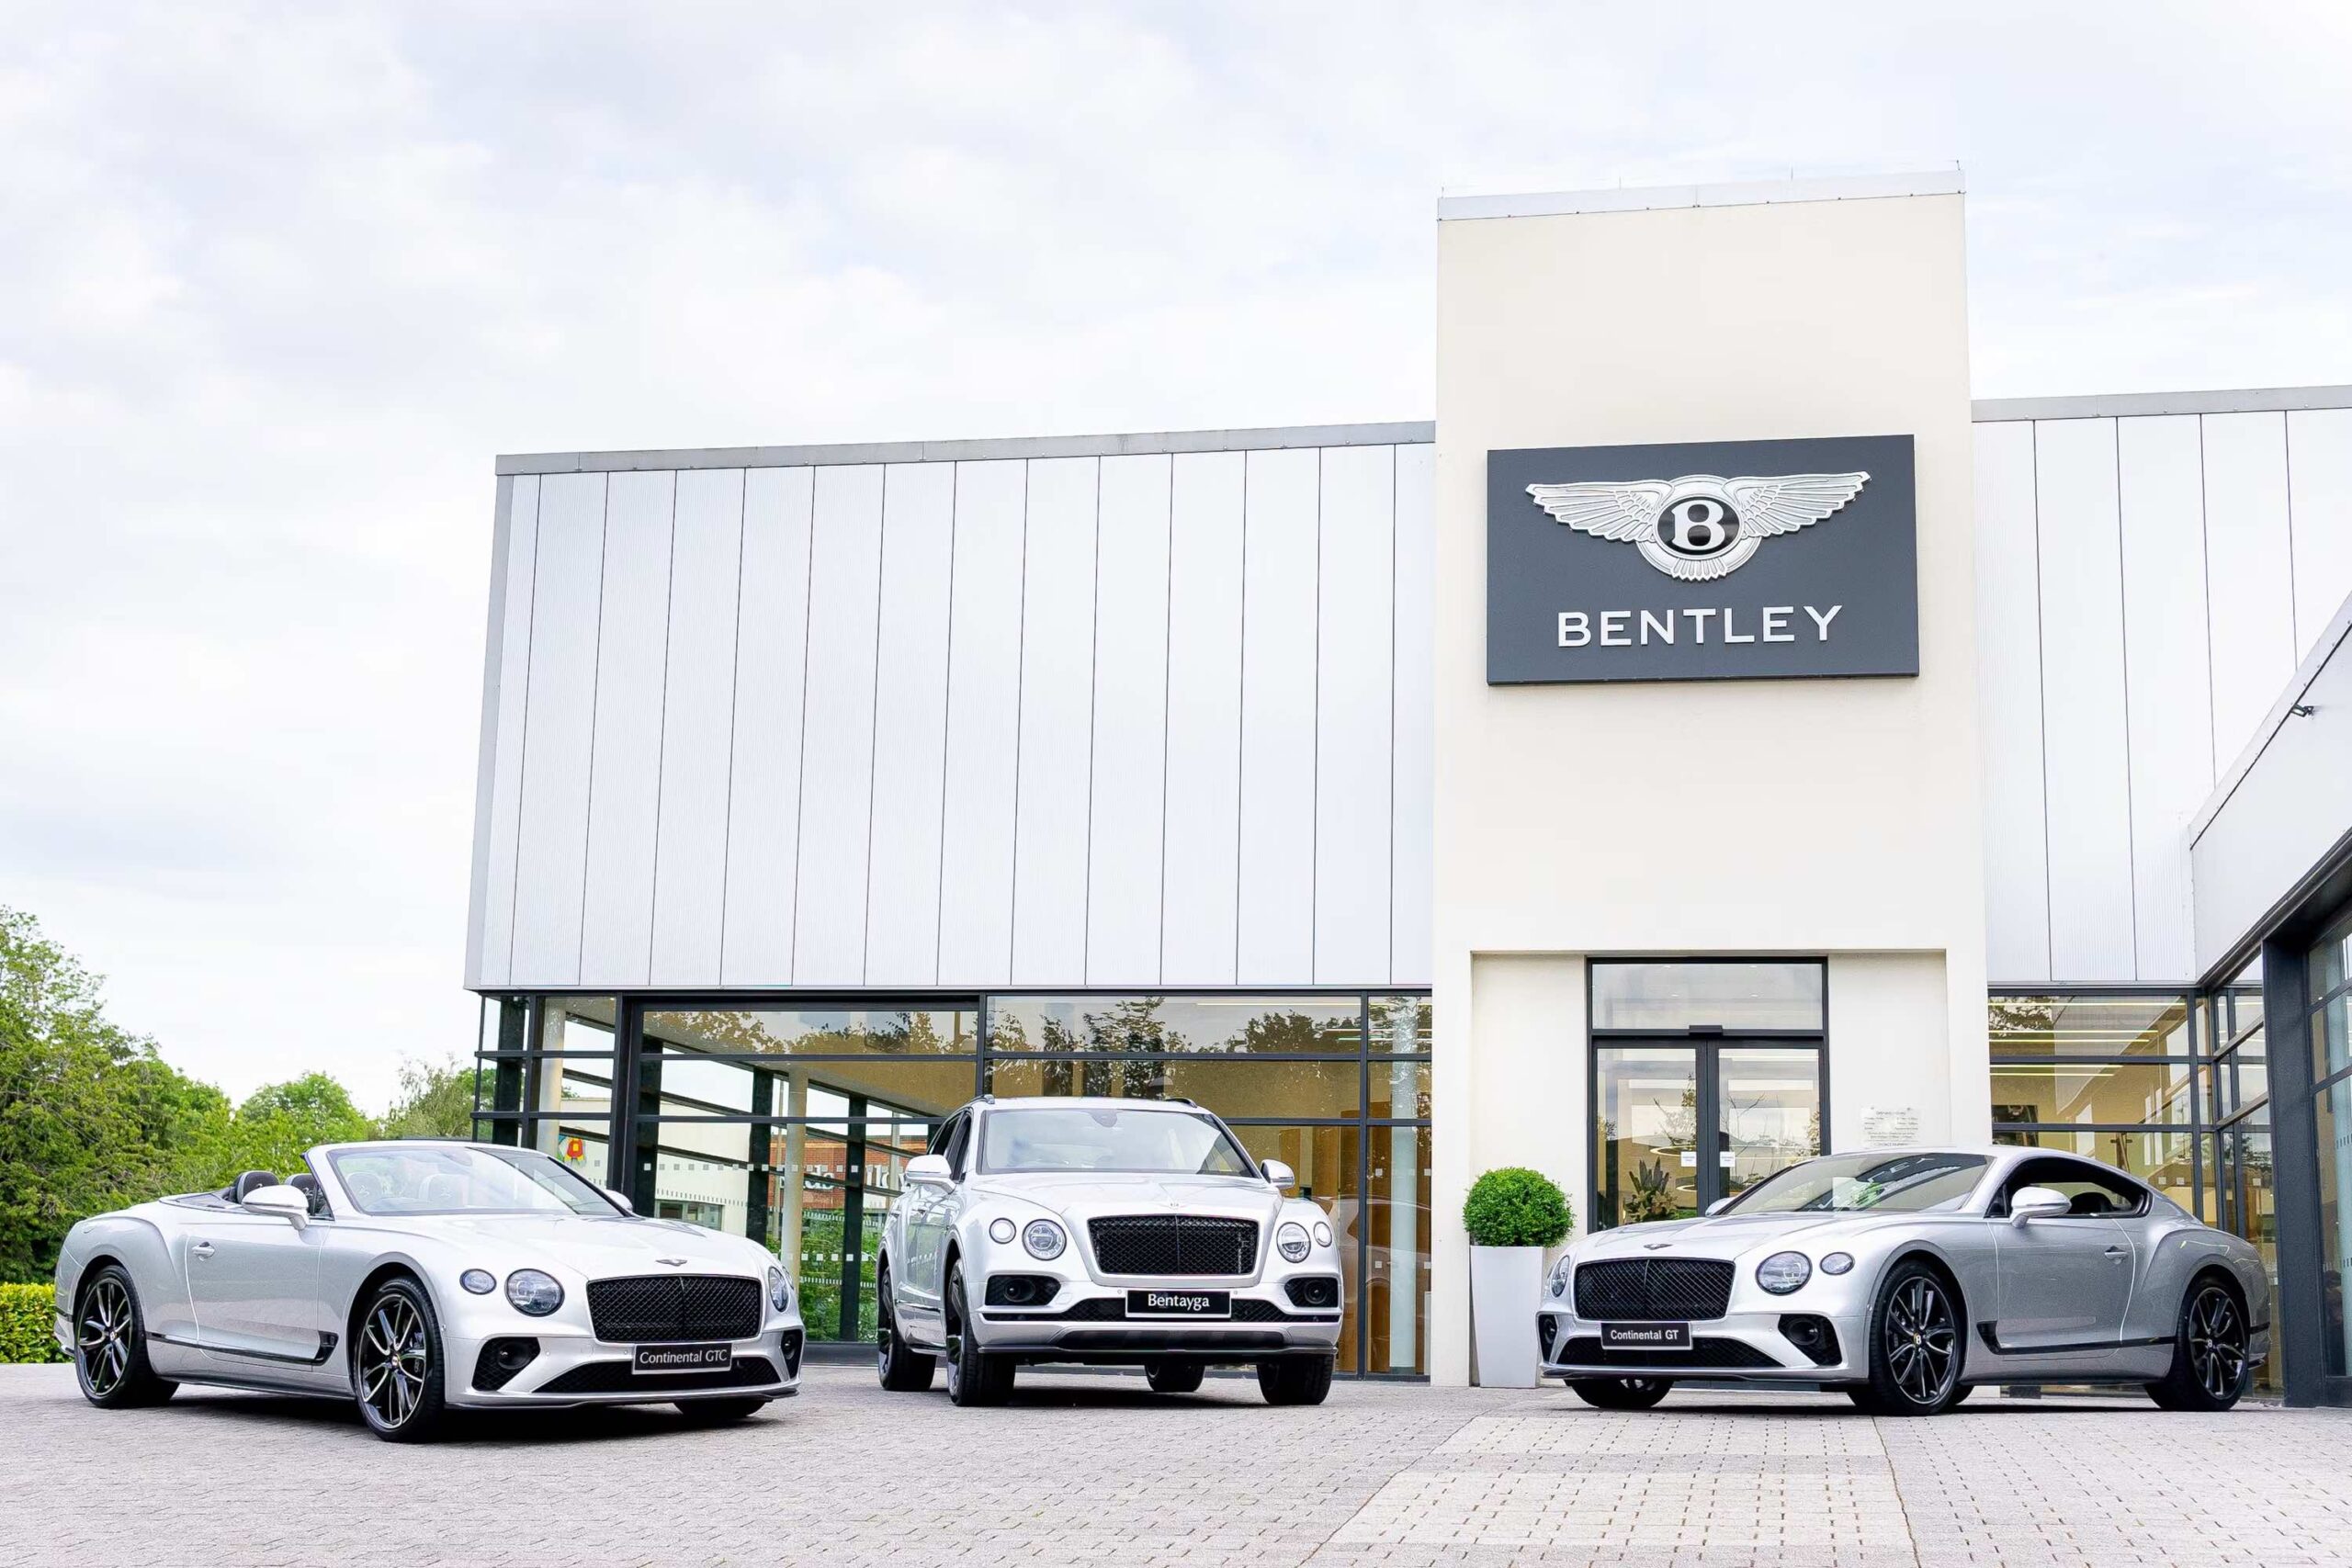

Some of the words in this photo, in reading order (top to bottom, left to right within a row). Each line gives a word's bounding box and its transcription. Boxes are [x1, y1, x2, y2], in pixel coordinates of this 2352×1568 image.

[1671, 499, 1725, 551] B
[1558, 604, 1843, 648] BENTLEY
[1148, 1293, 1210, 1312] Bentayga
[1611, 1329, 1662, 1340] Continental
[1665, 1329, 1679, 1340] GT
[639, 1350, 703, 1364] Continental
[705, 1349, 728, 1362] GTC
